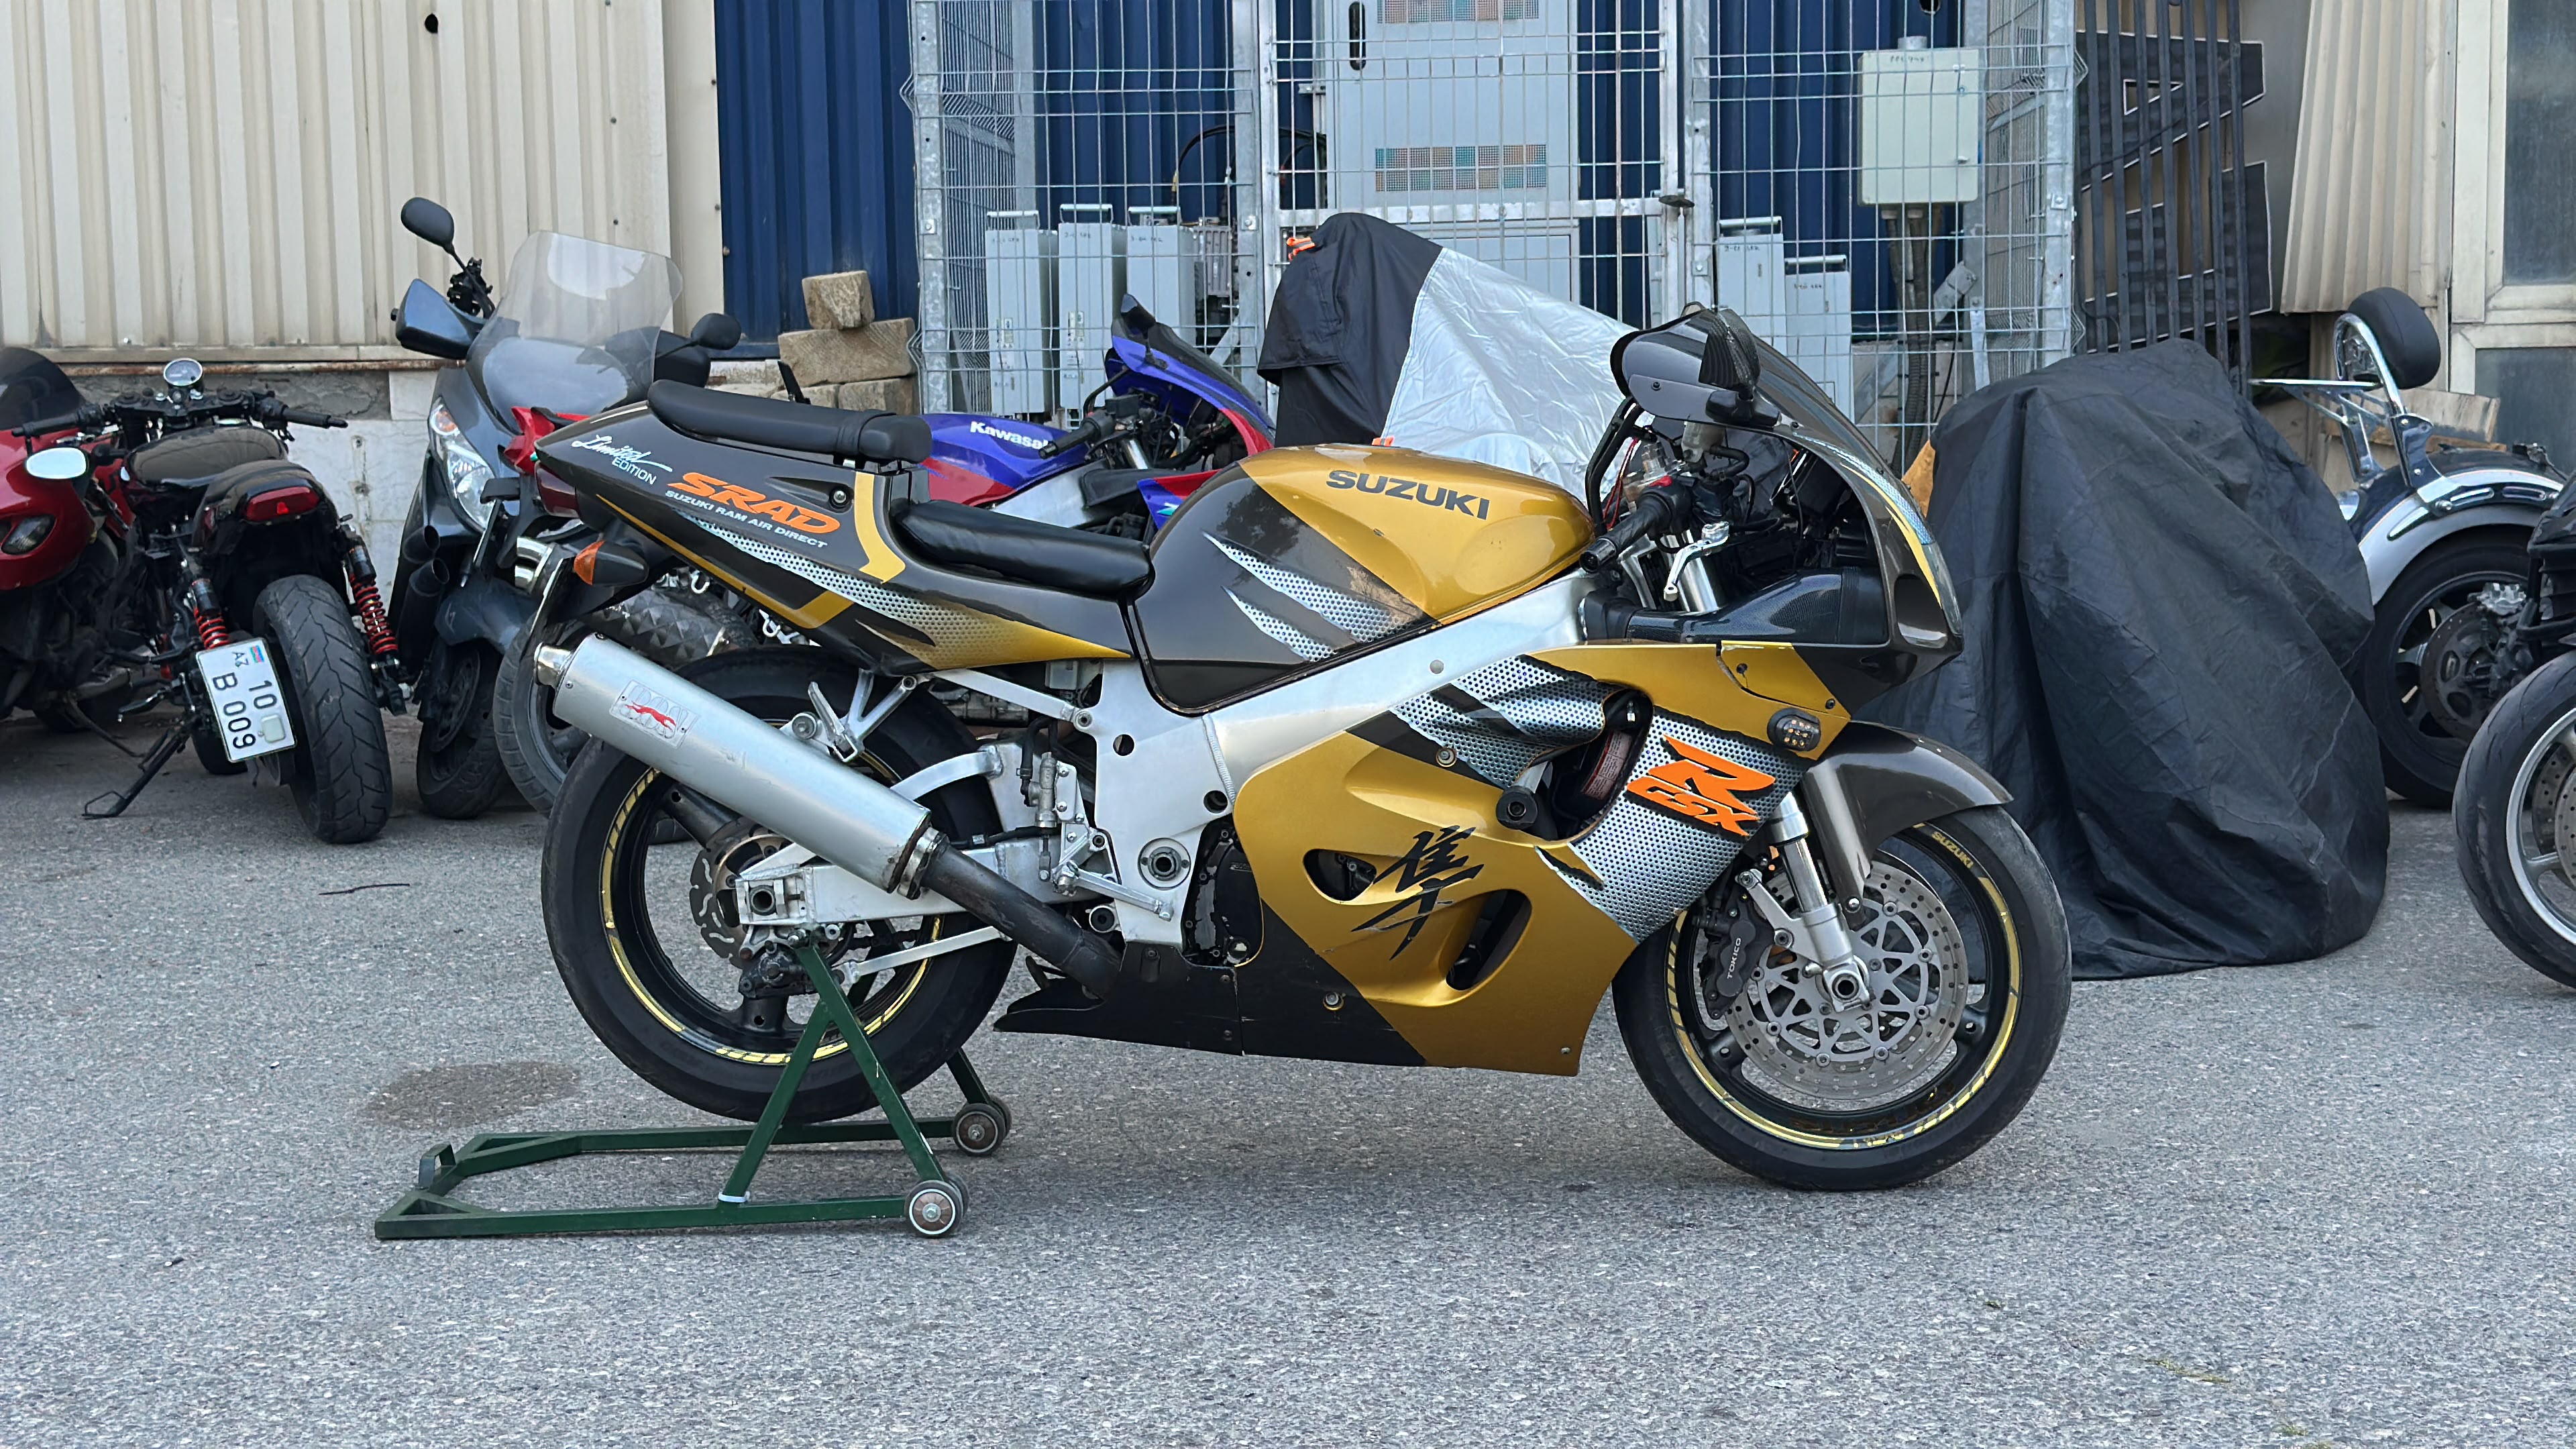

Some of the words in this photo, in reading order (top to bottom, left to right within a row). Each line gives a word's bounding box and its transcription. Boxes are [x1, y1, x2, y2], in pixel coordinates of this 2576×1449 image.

[572, 435, 673, 472] Limited
[612, 457, 657, 485] EDITION
[667, 472, 841, 534] SRAD
[1326, 470, 1490, 520] SUZUKI
[665, 490, 714, 511] SUZUKI
[715, 506, 748, 522] RAM
[748, 519, 773, 531] AIR
[774, 527, 828, 549] DIRECT
[212, 672, 238, 691] B
[231, 651, 249, 667] AZ
[248, 680, 278, 710] 10
[223, 701, 256, 749] 009
[1648, 734, 1776, 815] R
[1626, 775, 1761, 837] GSX
[1932, 831, 1974, 868] SUZUKI
[1351, 824, 1485, 961] 隼
[1727, 937, 1741, 979] TOKICO
